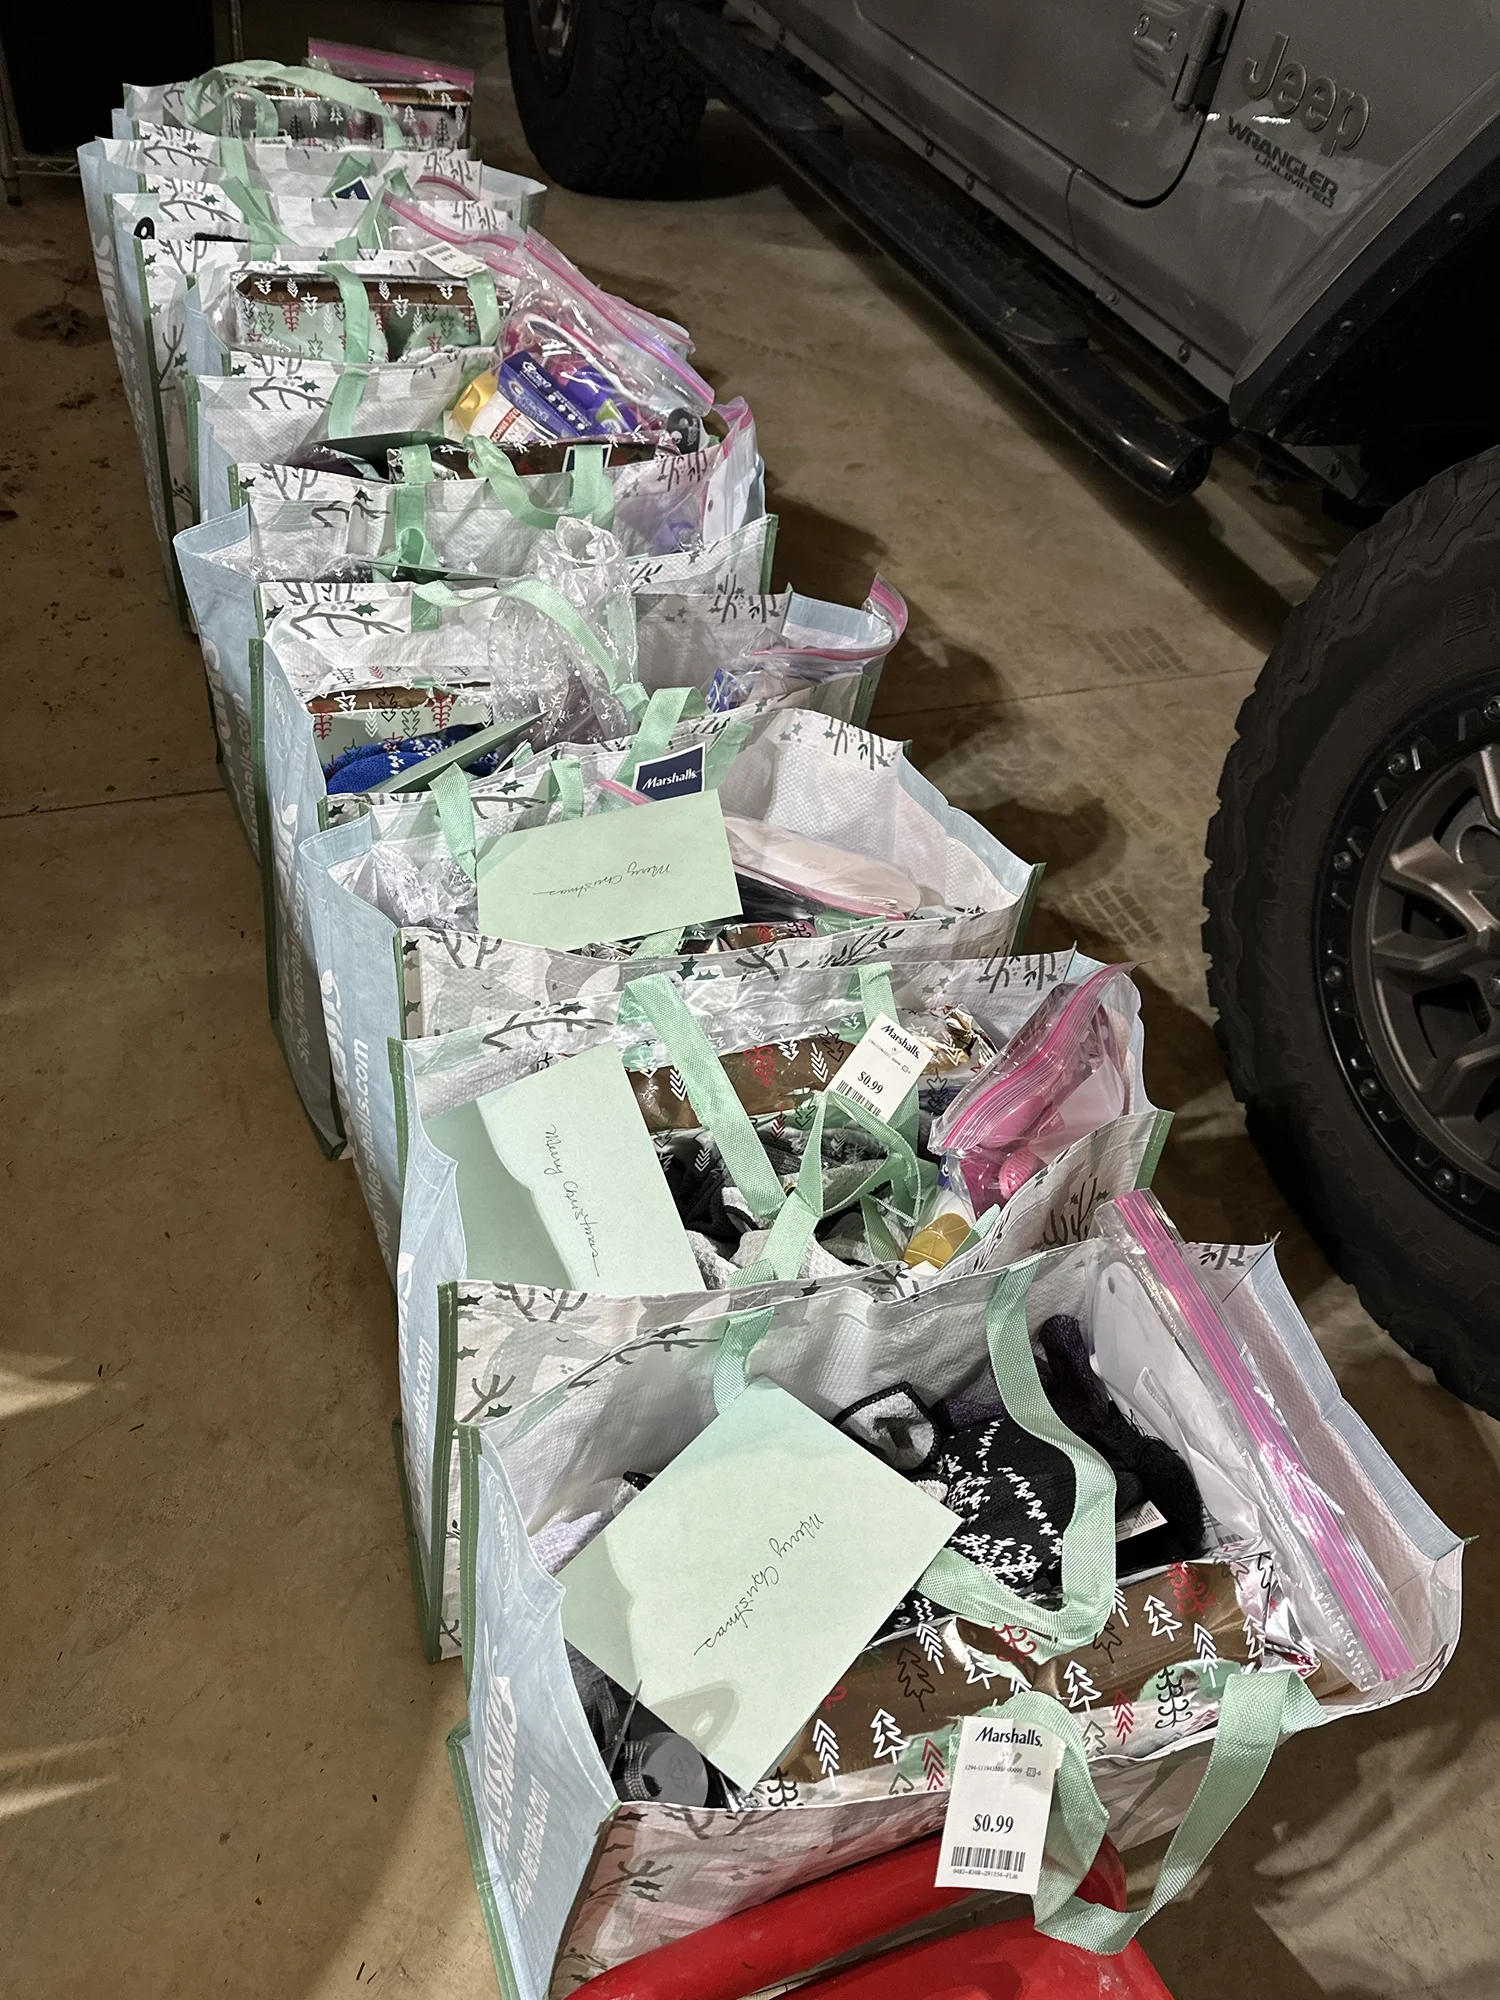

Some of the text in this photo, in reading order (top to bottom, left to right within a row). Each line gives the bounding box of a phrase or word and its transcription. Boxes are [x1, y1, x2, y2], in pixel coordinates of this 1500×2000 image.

[1241, 32, 1371, 158] Jeep
[1228, 116, 1338, 197] WRANGLER
[1254, 153, 1334, 209] UNLIMITED
[641, 768, 698, 790] Marshalls
[626, 860, 671, 878] Merry
[857, 1071, 884, 1095] $0.99
[354, 1038, 386, 1206] Marshalls.com
[543, 1123, 563, 1175] Merry
[769, 1513, 824, 1558] Merry
[516, 1773, 551, 1882] Marshalls.com
[972, 1813, 1015, 1835] $0.99
